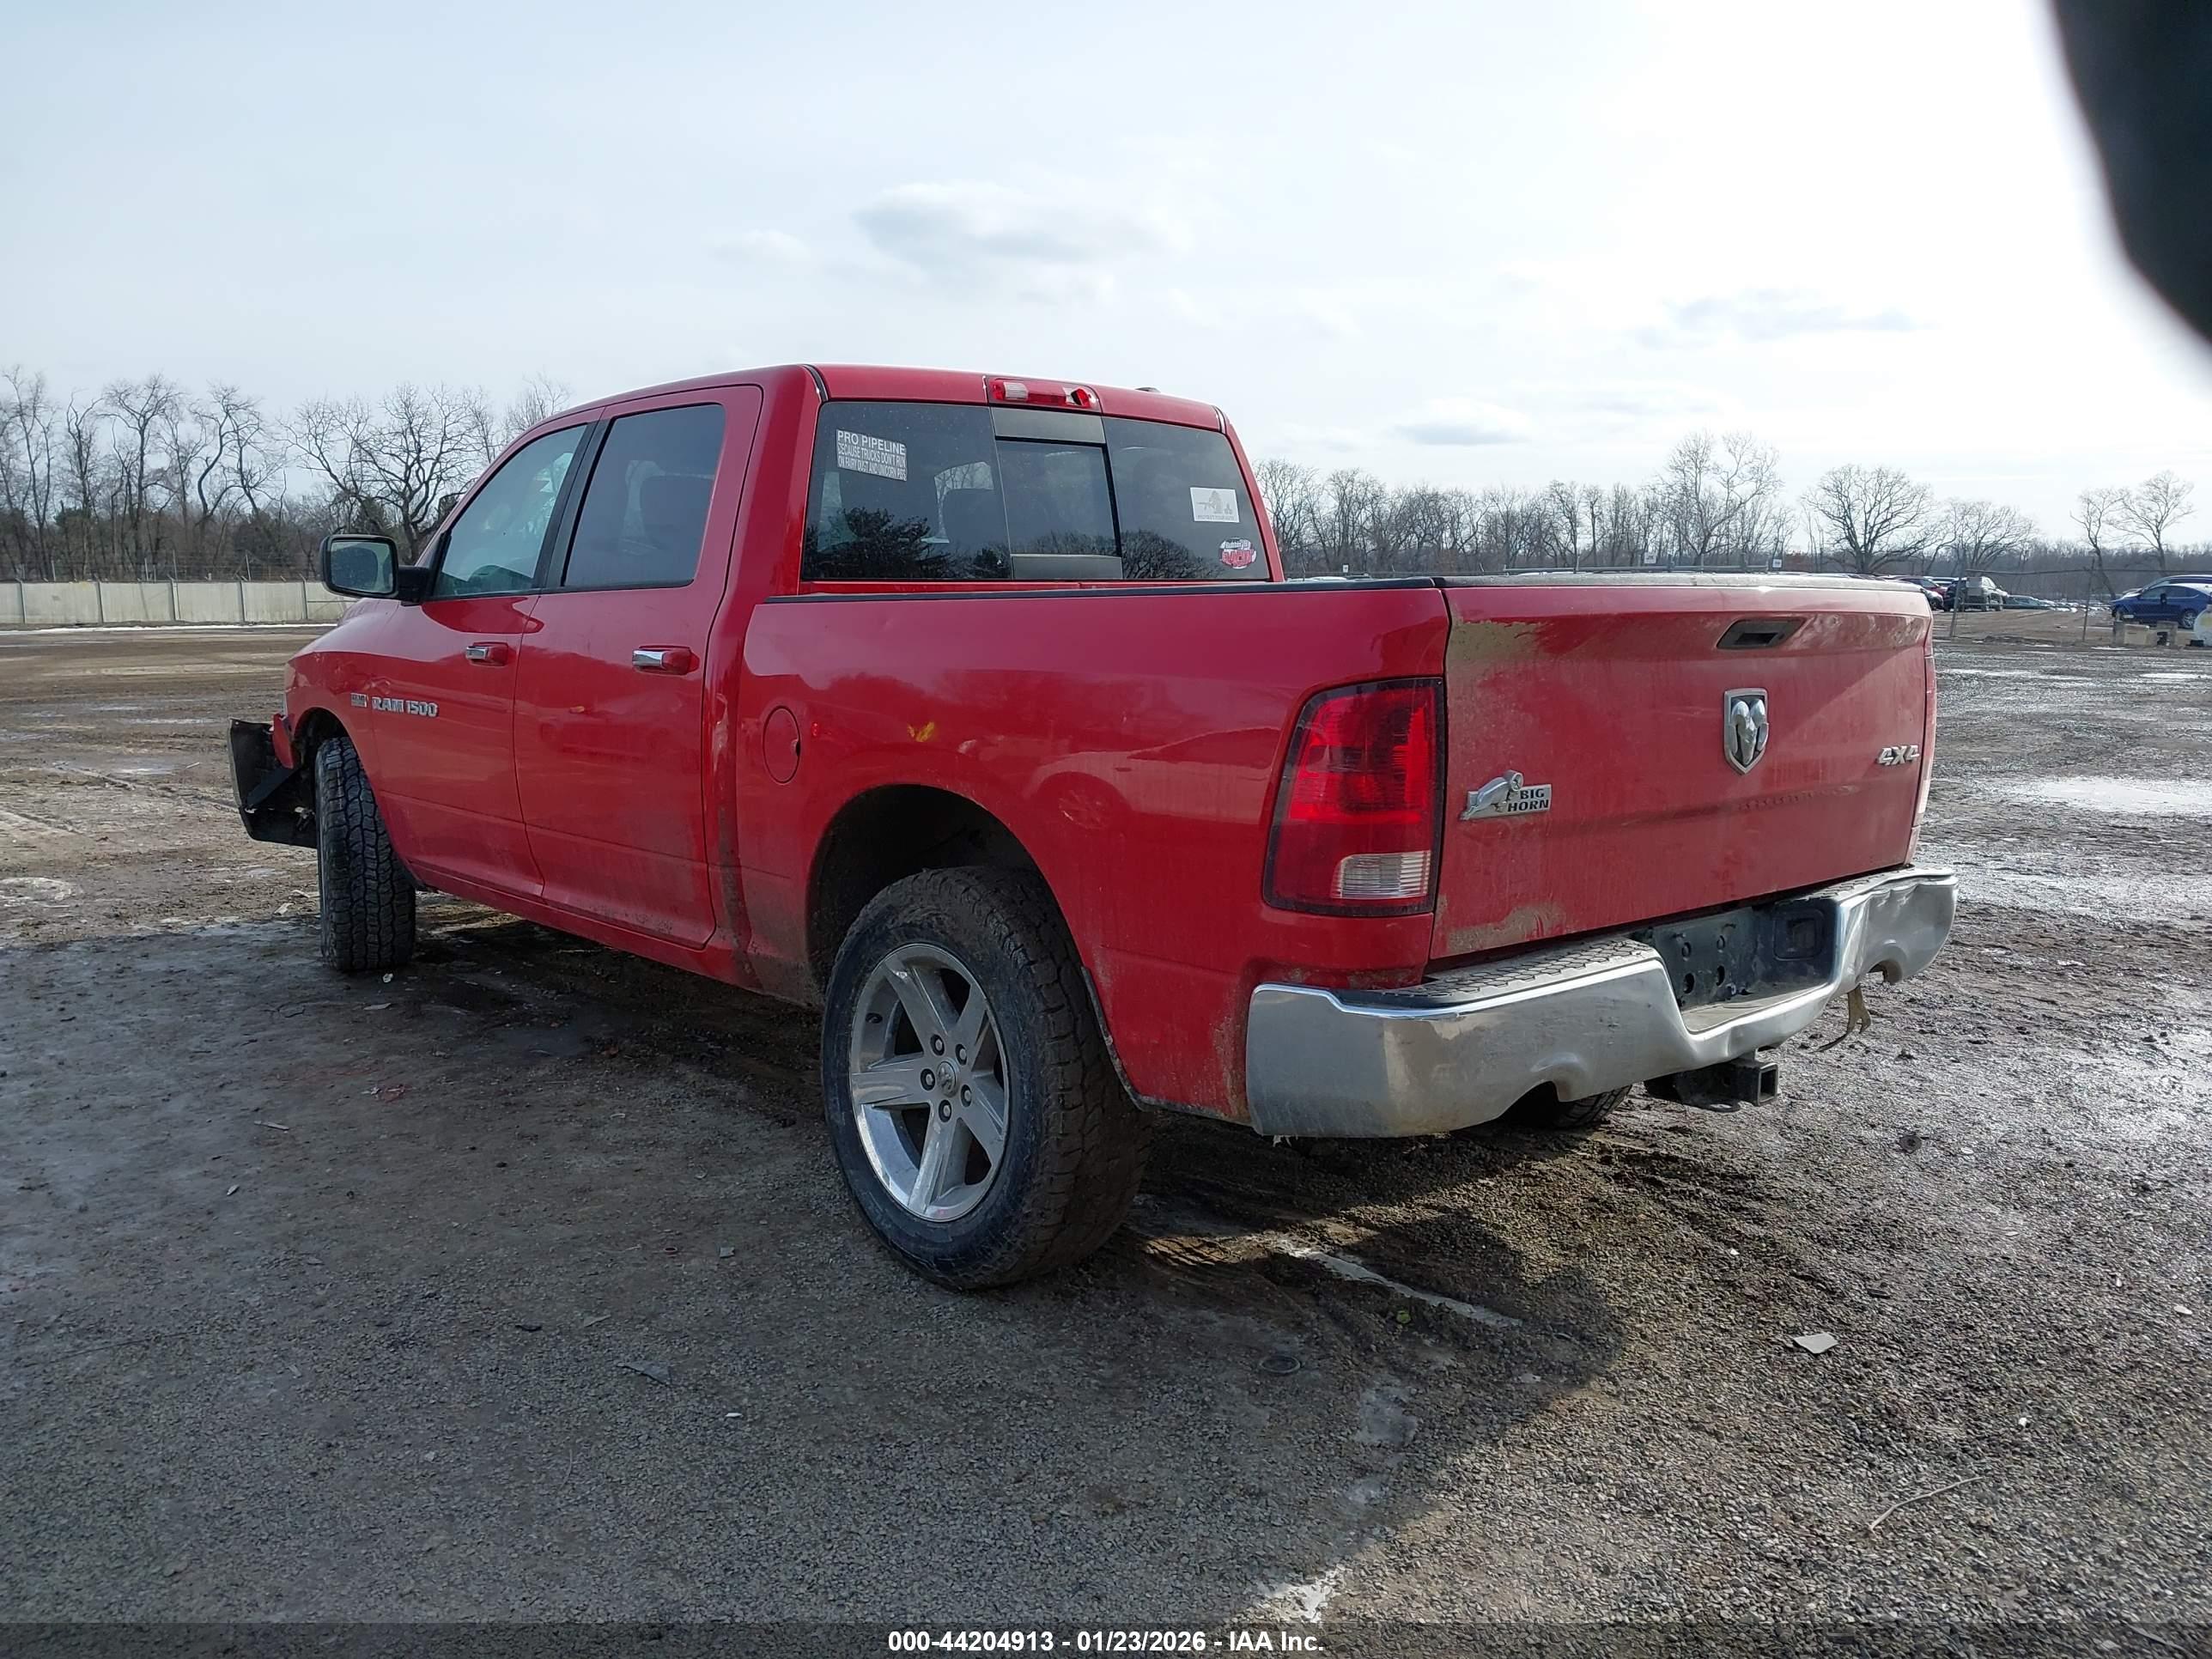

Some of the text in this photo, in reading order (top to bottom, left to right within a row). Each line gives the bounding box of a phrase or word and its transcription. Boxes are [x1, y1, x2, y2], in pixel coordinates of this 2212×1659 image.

[837, 430, 906, 455] PRO PIPELINE
[837, 442, 860, 459] BECAUSE
[860, 447, 881, 463] TRUCKS
[896, 455, 906, 468] RUN
[371, 696, 438, 718] RAM 1500
[1520, 788, 1545, 799] BIG
[1507, 799, 1549, 812] HORN
